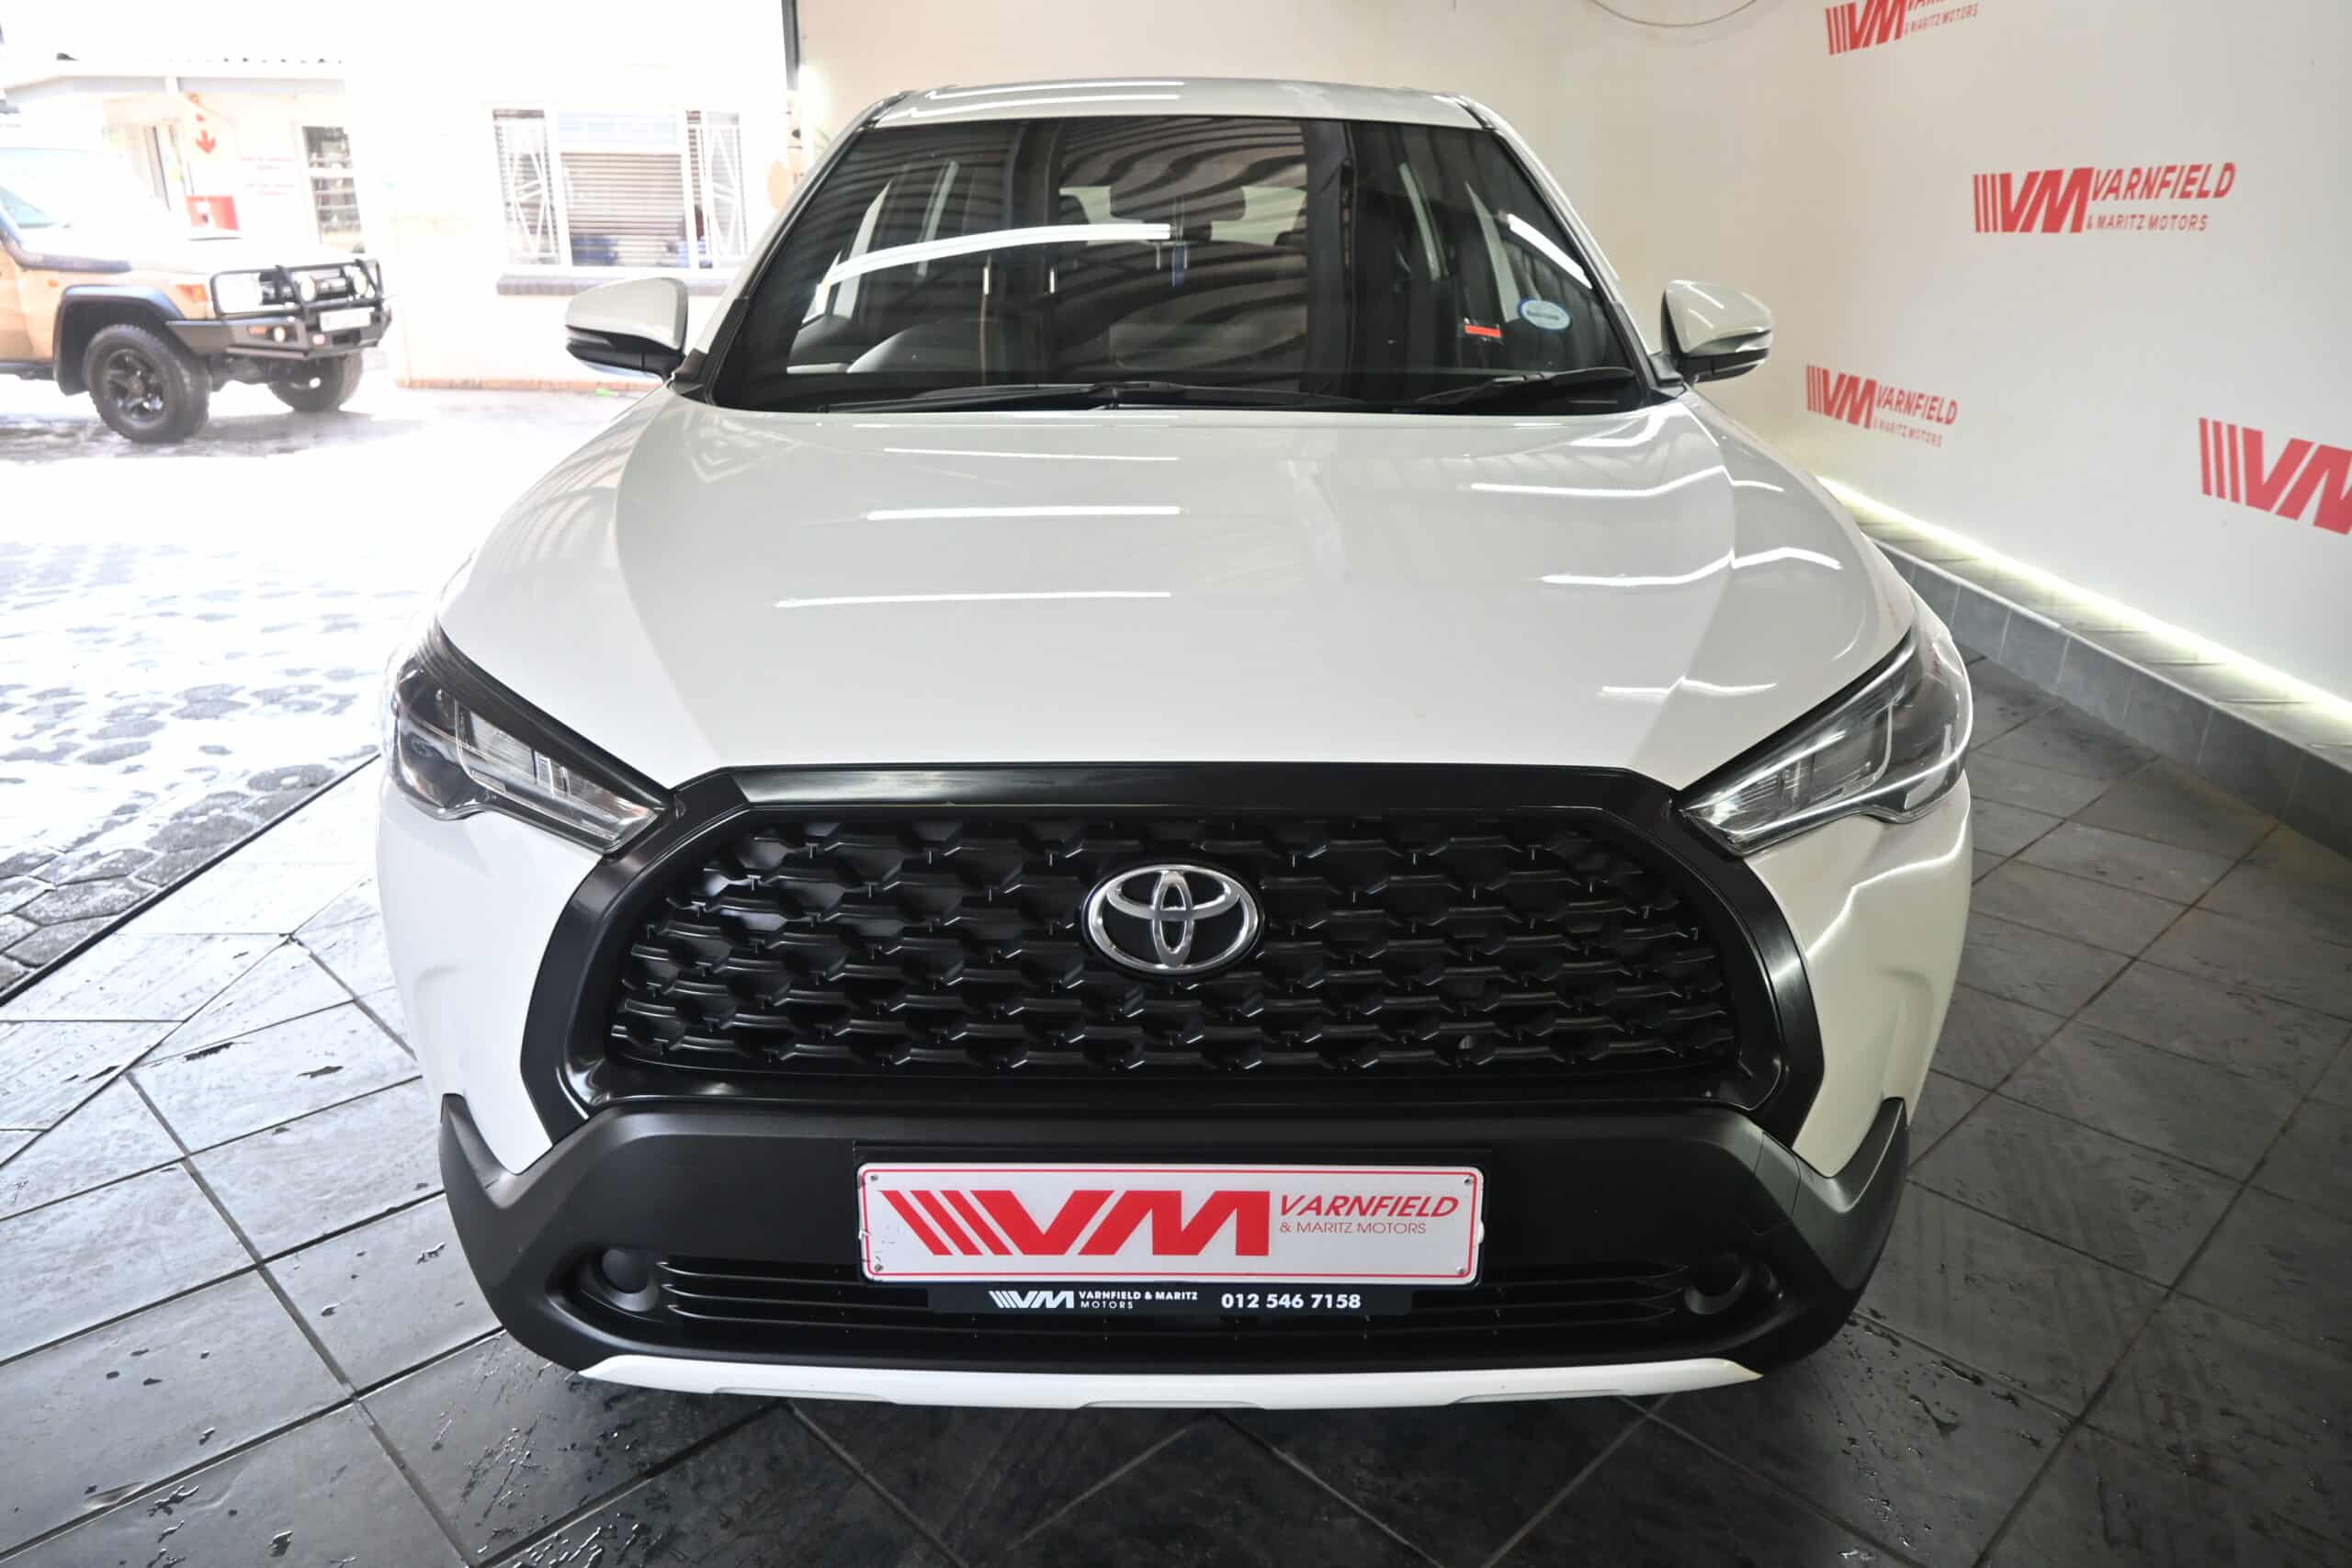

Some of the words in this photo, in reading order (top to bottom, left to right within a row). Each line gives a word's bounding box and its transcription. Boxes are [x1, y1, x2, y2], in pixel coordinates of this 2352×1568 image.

[2091, 162, 2236, 201] VARNFIELD
[2097, 213, 2145, 231] MARITZ
[2147, 214, 2209, 231] MOTORS
[1876, 384, 1958, 425] VARNFIELD
[1280, 1195, 1460, 1218] VARNFIELD
[1279, 1222, 1292, 1234] &
[1296, 1222, 1353, 1234] MARITZ
[1357, 1223, 1427, 1235] MOTORS
[1079, 1291, 1142, 1300] VARNFIELD
[1145, 1292, 1153, 1301] &
[1155, 1292, 1199, 1301] MARITZ
[1221, 1293, 1260, 1309] 012
[1265, 1293, 1305, 1309] 546
[1310, 1293, 1362, 1309] 7158
[1080, 1301, 1134, 1309] MOTORS
